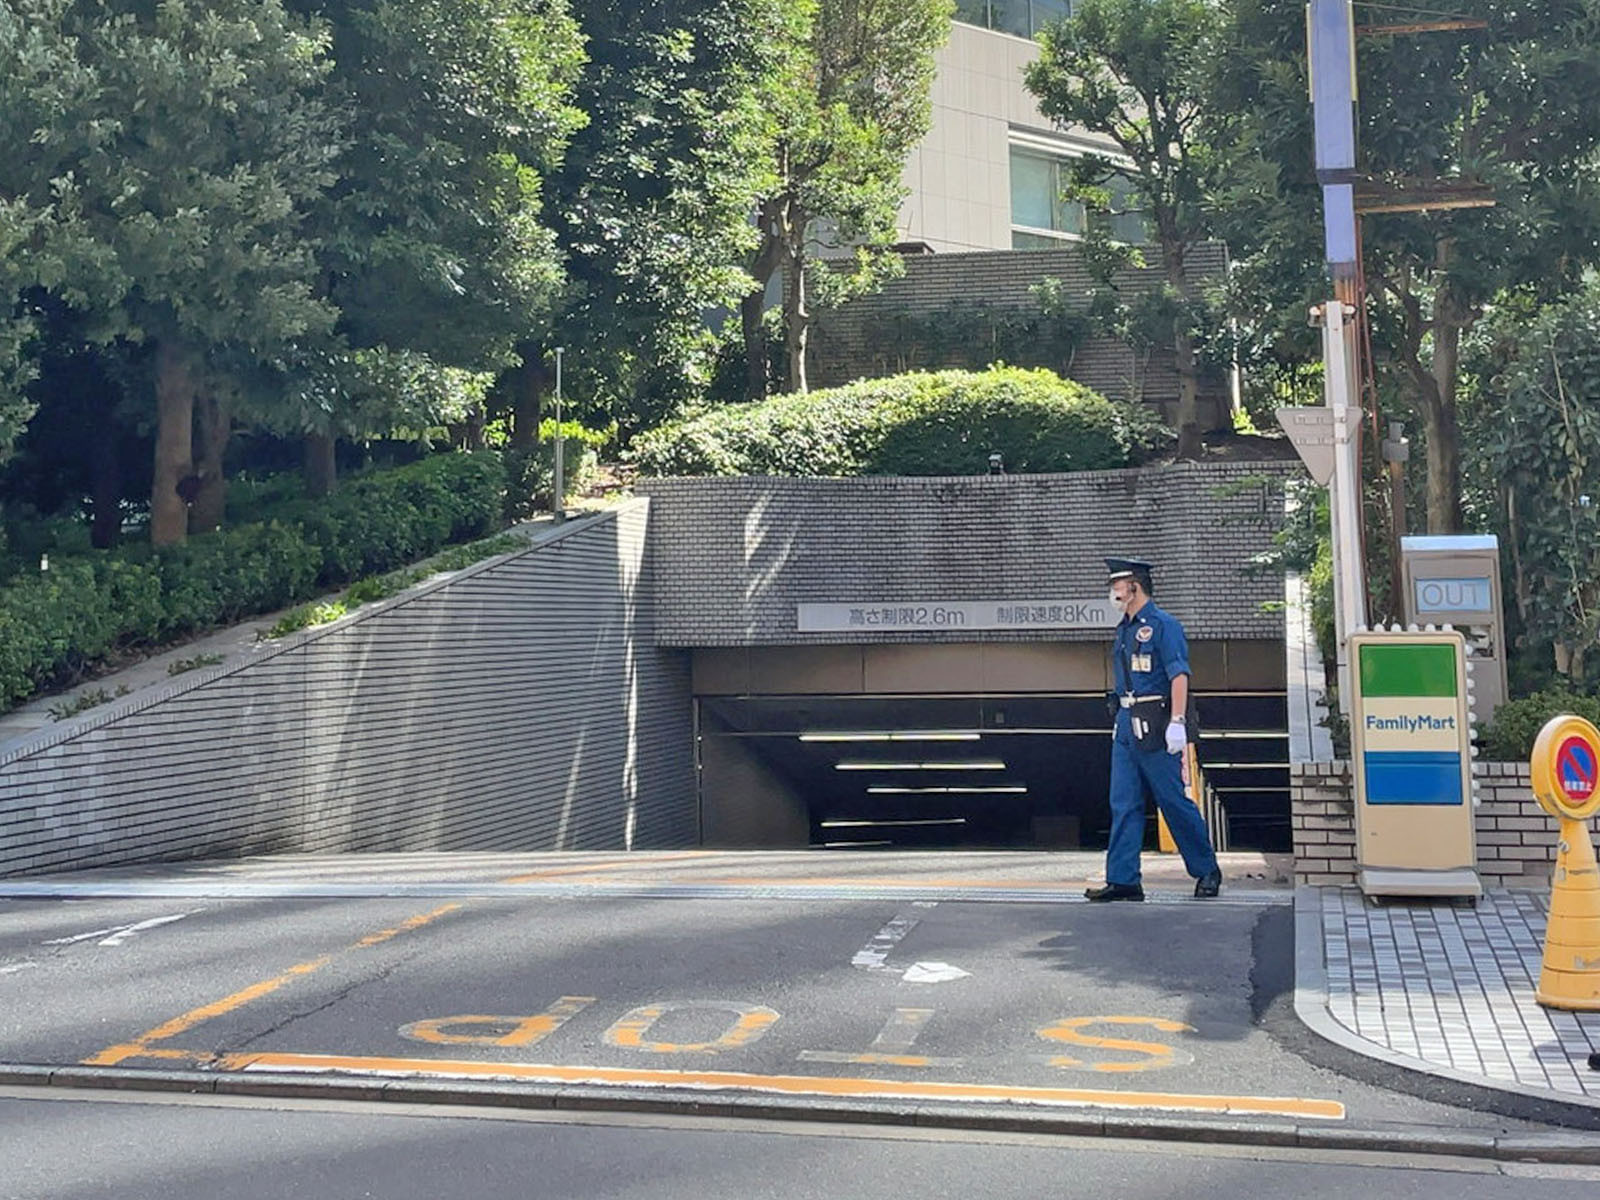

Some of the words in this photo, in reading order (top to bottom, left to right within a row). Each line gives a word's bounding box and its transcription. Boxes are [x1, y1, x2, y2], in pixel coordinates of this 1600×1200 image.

[1422, 583, 1479, 606] OUT
[848, 606, 965, 626] 高さ制限2.6m
[997, 604, 1106, 625] 制限速度8Km
[1366, 715, 1456, 733] FamilyMart
[398, 996, 1196, 1074] STOP
